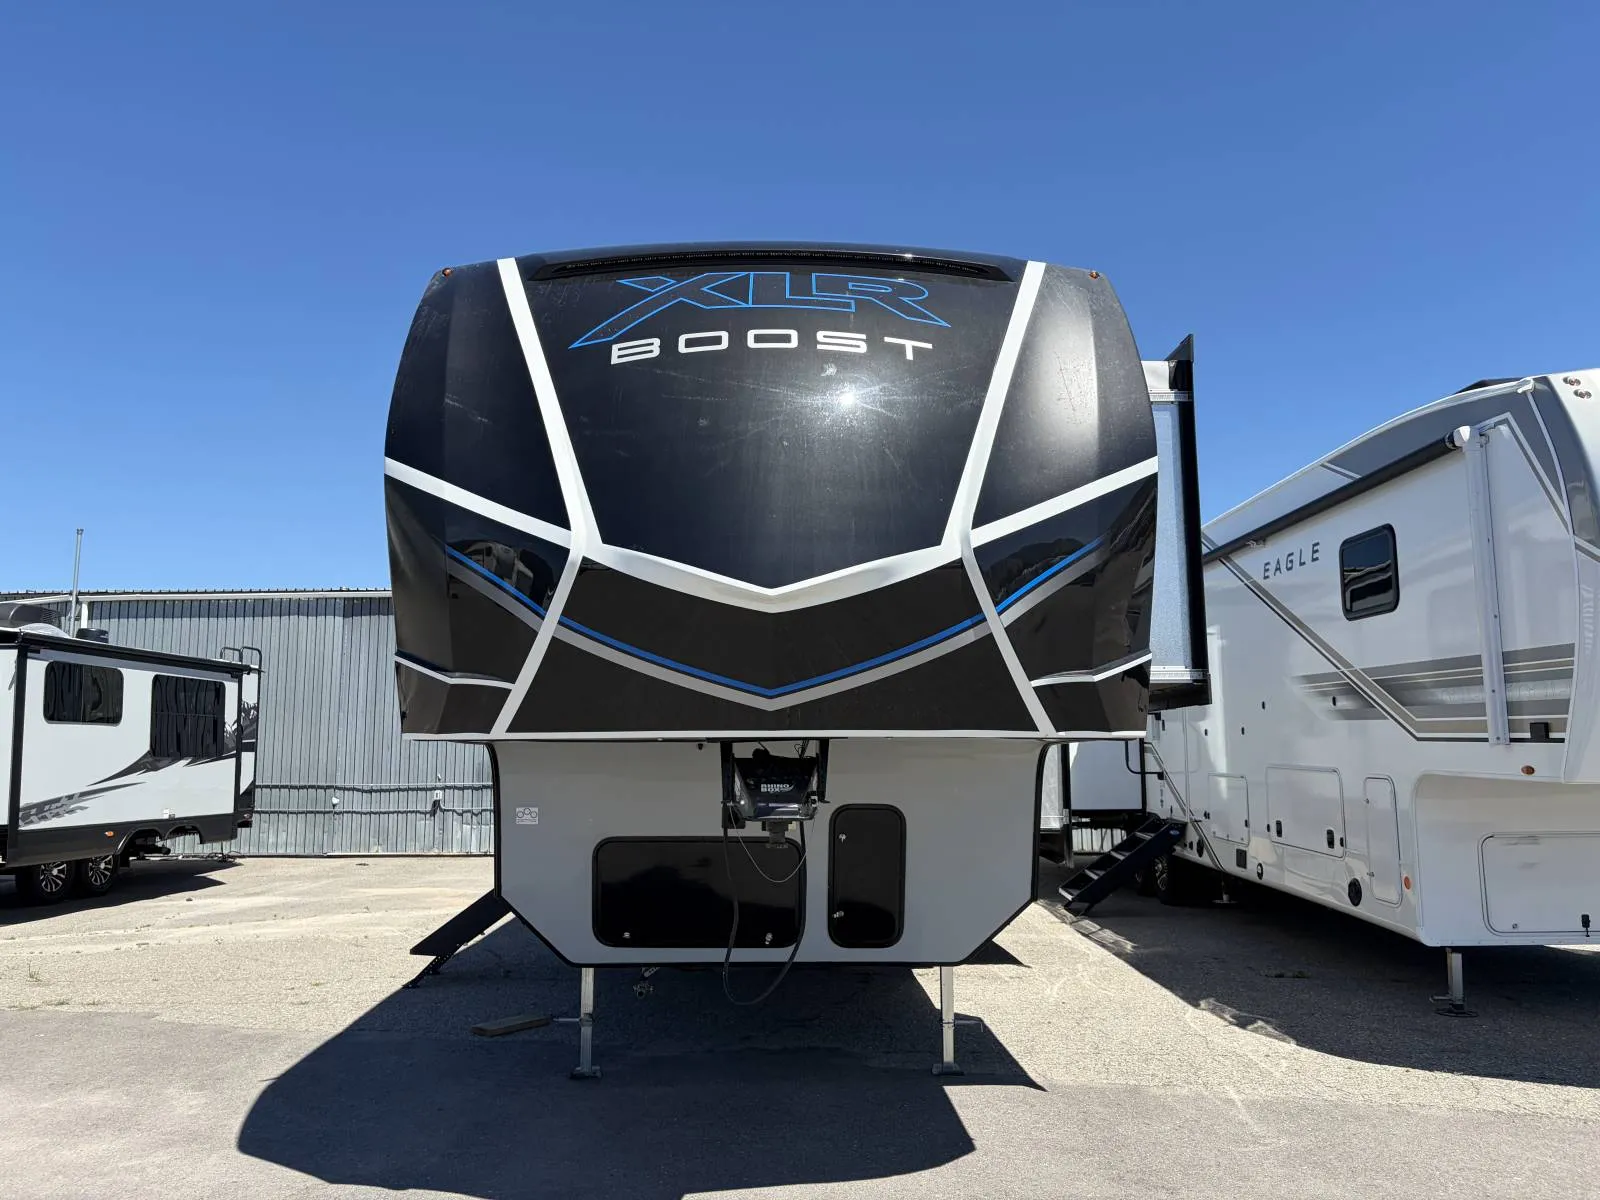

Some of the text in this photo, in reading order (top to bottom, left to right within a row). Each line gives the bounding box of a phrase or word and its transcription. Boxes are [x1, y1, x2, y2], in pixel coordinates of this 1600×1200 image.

[568, 271, 952, 349] XLR
[610, 328, 933, 365] BOOST
[1263, 542, 1320, 580] EAGLE
